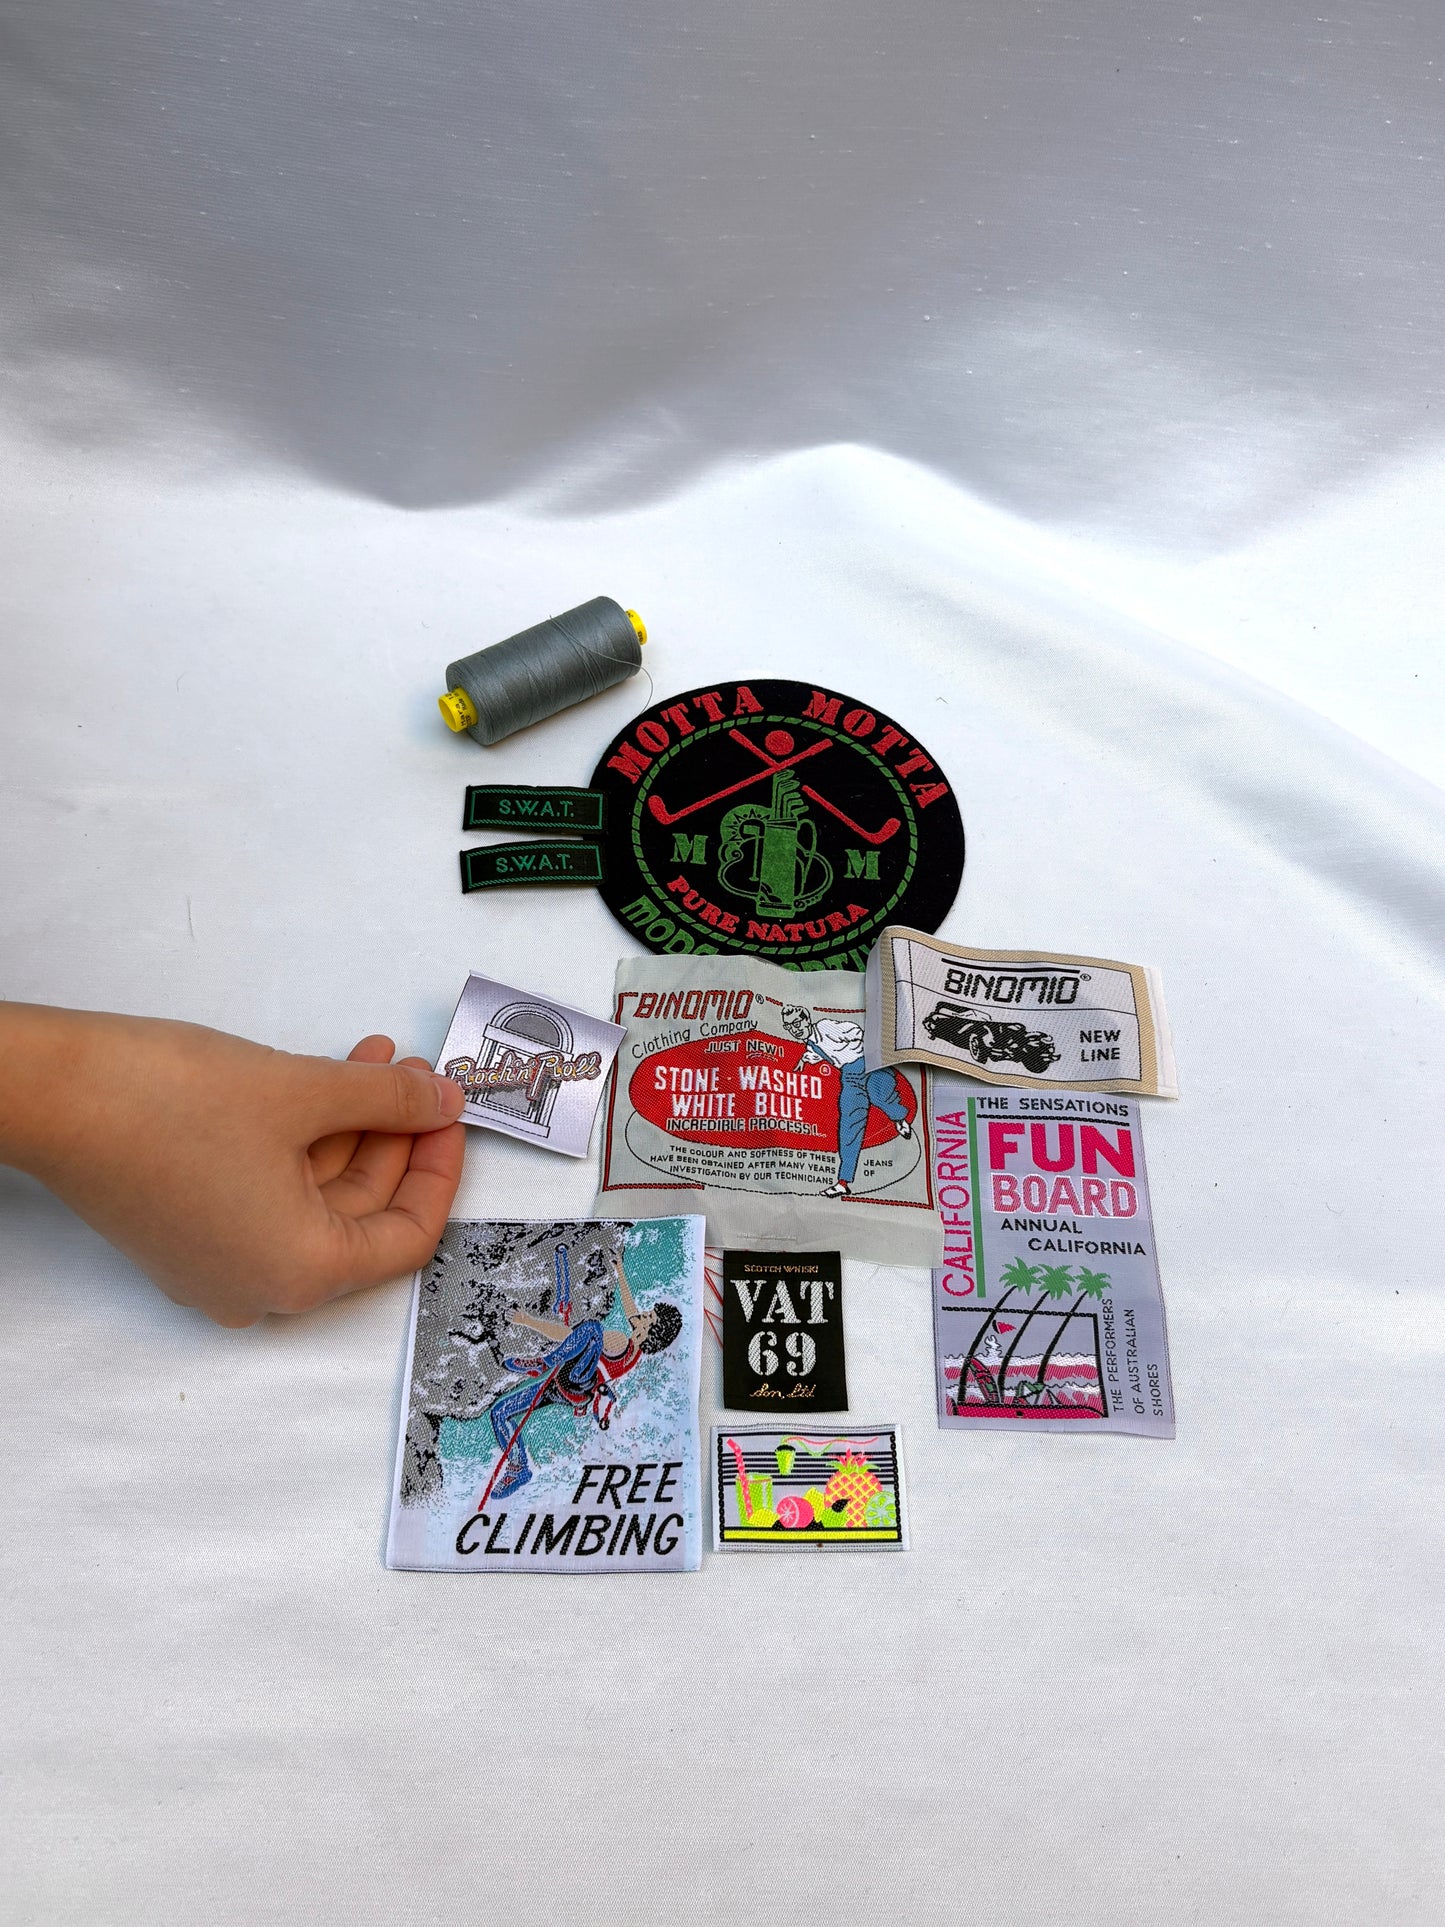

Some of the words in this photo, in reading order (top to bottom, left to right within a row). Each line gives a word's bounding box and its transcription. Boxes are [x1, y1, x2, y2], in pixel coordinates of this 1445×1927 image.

[607, 687, 764, 784] MOTTA
[802, 691, 949, 808] MOTTA
[499, 799, 575, 818] S.W.A.T.
[670, 833, 708, 865] M
[496, 853, 573, 873] S.W.A.T.
[844, 849, 880, 880] M
[666, 875, 740, 934] PURE
[745, 903, 869, 942] NATURA
[631, 1028, 691, 1059] Clothing
[699, 1019, 758, 1038] Company
[704, 1040, 740, 1053] JUST
[1080, 1029, 1121, 1044] NEW
[1081, 1048, 1121, 1062] LINE
[654, 1065, 720, 1092] STONE
[671, 1092, 736, 1118] WHITE
[754, 1092, 804, 1120] BLUE
[977, 1096, 1009, 1110] THE
[1018, 1097, 1129, 1117] SENSATIONS
[666, 1118, 745, 1132] INCREDIBLE
[670, 1145, 687, 1154] THE
[689, 1148, 725, 1158] COLOUR
[727, 1150, 748, 1159] AND
[750, 1150, 794, 1159] SOFTNESS
[796, 1151, 808, 1159] OF
[810, 1153, 836, 1164] THESE
[987, 1121, 1136, 1178] FUN
[649, 1154, 674, 1163] HAVE
[676, 1155, 699, 1165] BEEN
[701, 1158, 744, 1170] OBTAINED
[747, 1161, 776, 1170] AFTER
[778, 1161, 805, 1170] MANY
[807, 1163, 836, 1175] YEARS
[669, 1165, 737, 1179] INVESTIGATION
[739, 1171, 752, 1180] BY
[753, 1171, 773, 1180] OUR
[774, 1172, 834, 1185] TECHNICIANS
[935, 1111, 975, 1297] CALIFORNIA
[990, 1172, 1139, 1220] BOARD
[1000, 1218, 1083, 1235] ANNUAL
[1027, 1237, 1148, 1257] CALIFORNIA
[744, 1264, 782, 1274] SCOTCH
[729, 1279, 835, 1325] VAT
[747, 1330, 817, 1377] 69
[1102, 1298, 1119, 1382] PERFORMERS
[1123, 1309, 1142, 1393] AUSTRALIAN
[1111, 1389, 1124, 1412] THE
[1146, 1363, 1164, 1417] SHORES
[1133, 1397, 1146, 1414] OF
[571, 1462, 683, 1509] FREE
[455, 1513, 684, 1556] CLIMBING
